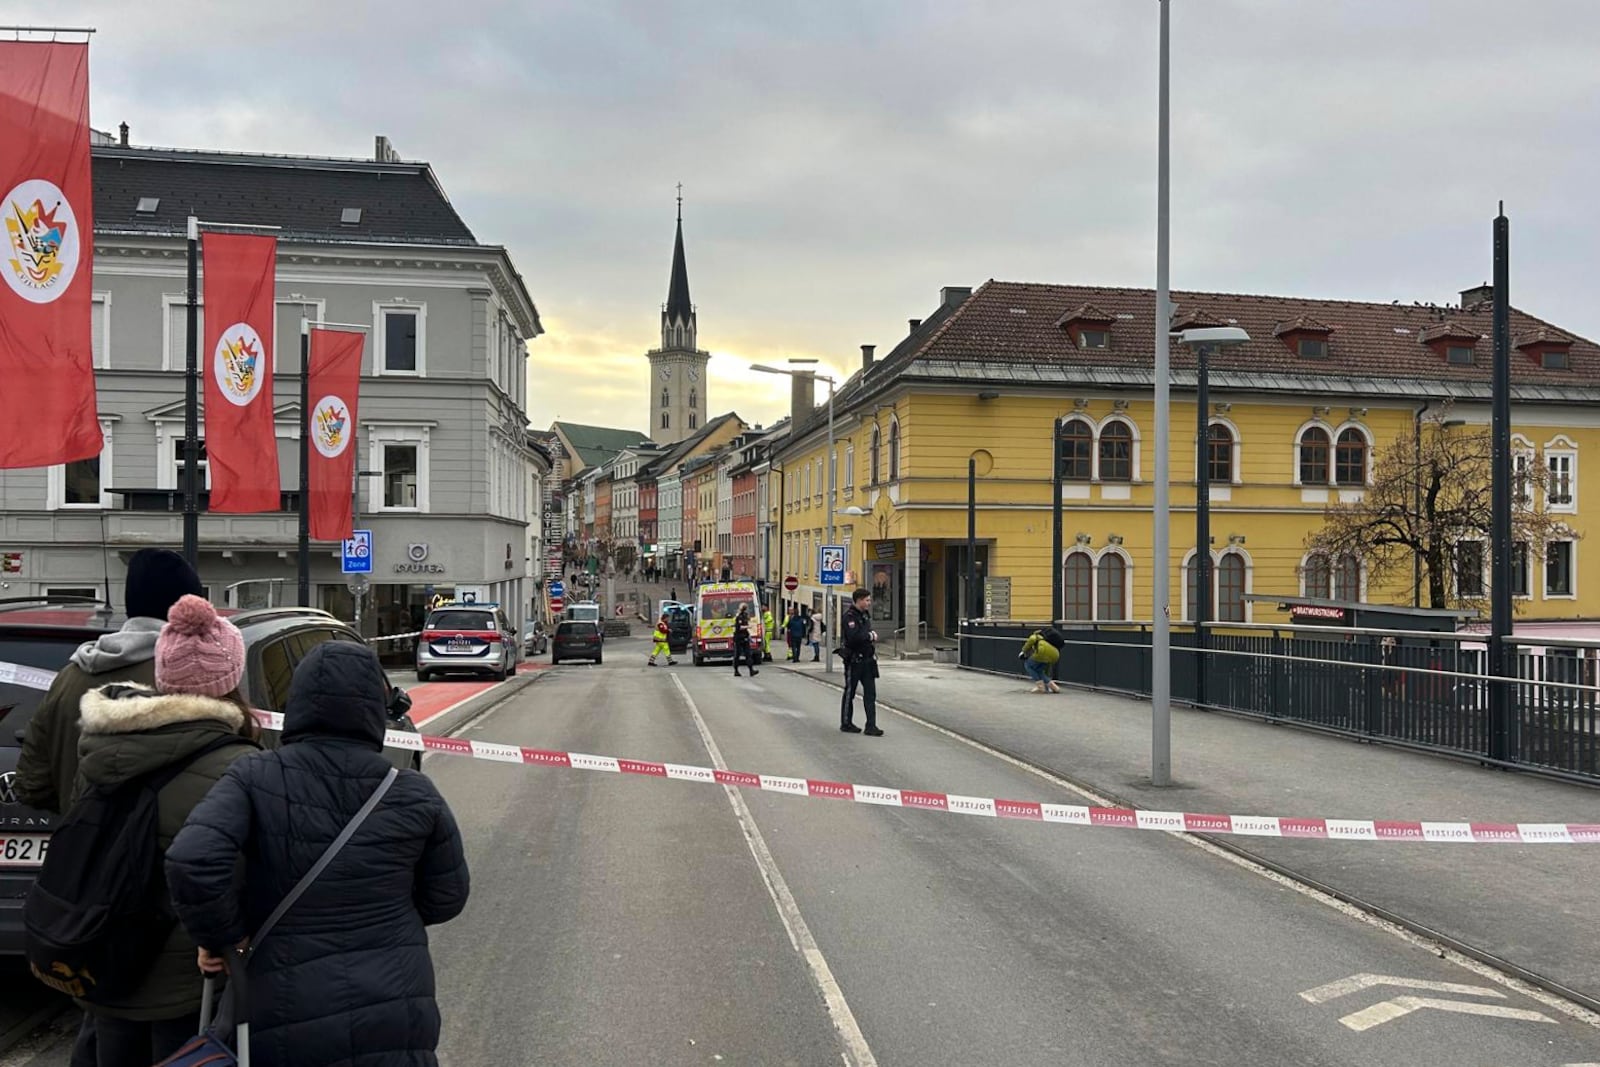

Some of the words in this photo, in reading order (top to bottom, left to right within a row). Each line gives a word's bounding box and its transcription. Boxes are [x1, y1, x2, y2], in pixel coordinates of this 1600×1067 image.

[19, 272, 58, 290] VILLACH
[543, 503, 552, 546] HOTEL
[358, 548, 367, 556] 20
[347, 559, 367, 568] Zone
[824, 574, 841, 582] Zone
[5, 838, 33, 860] 62
